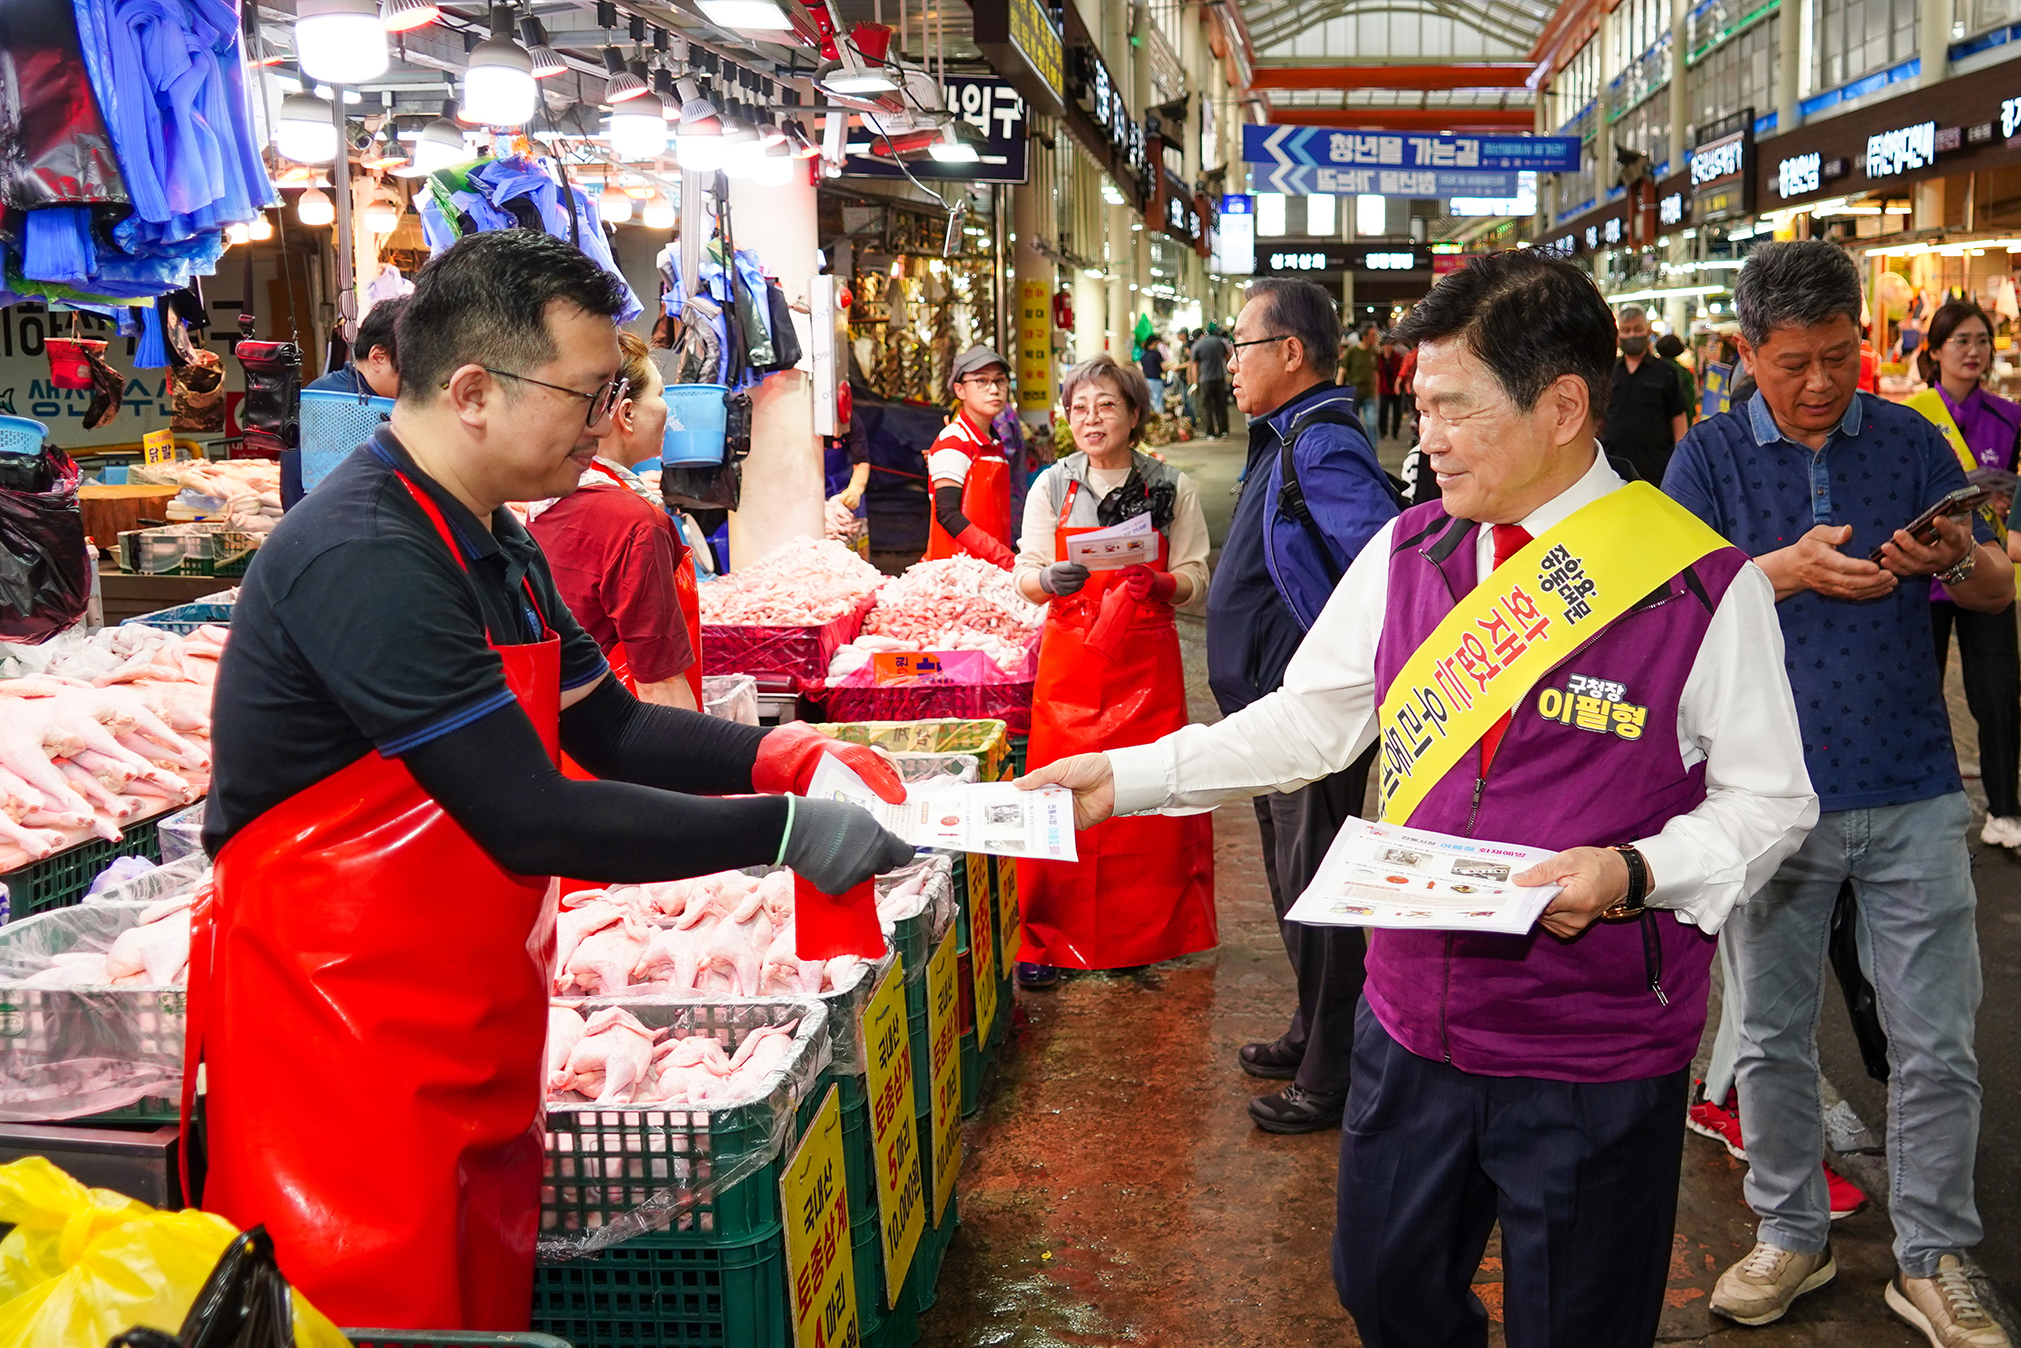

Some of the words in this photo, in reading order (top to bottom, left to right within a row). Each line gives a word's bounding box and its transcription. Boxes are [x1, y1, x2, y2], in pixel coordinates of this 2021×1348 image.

[1329, 133, 1402, 165] 청년몰
[1540, 689, 1647, 739] 이필형
[1567, 674, 1626, 701] 구청장
[878, 1012, 900, 1070] 국내산
[875, 1041, 912, 1144] 토종삼계
[804, 1157, 833, 1235] 국내산
[797, 1185, 848, 1326] 토종삼계
